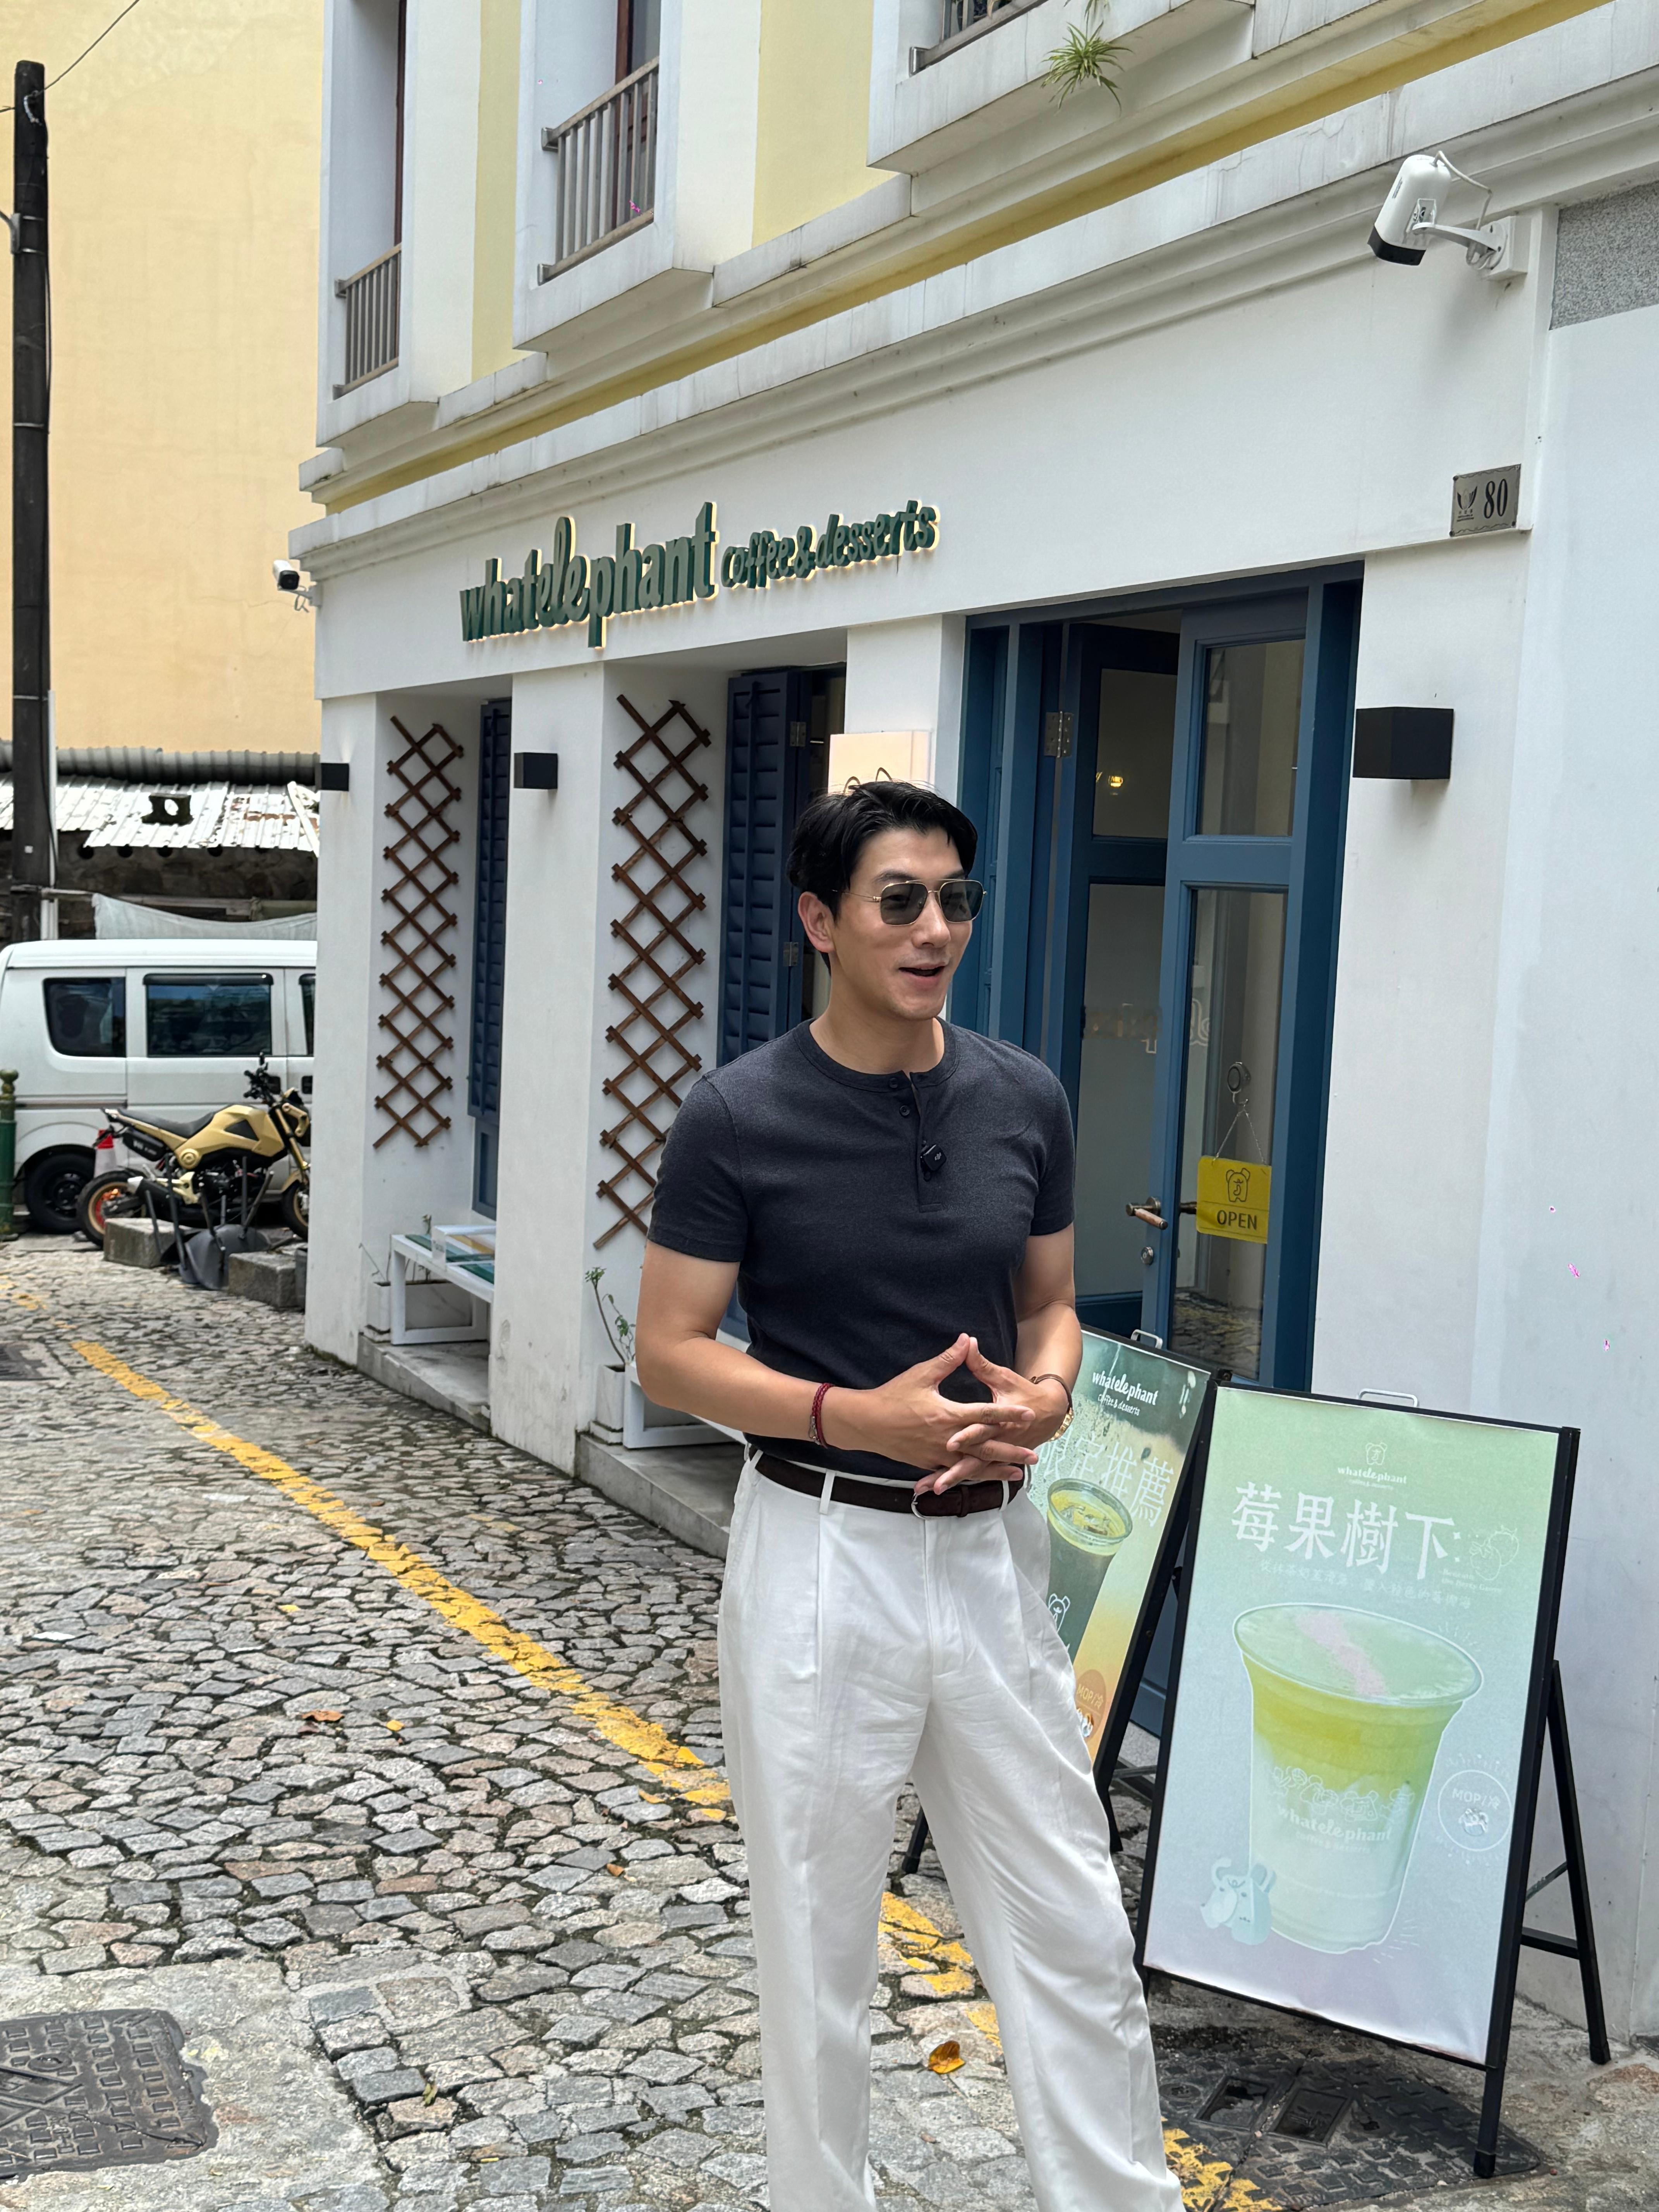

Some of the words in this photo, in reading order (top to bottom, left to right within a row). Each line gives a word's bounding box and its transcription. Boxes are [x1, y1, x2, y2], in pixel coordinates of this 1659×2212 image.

[1484, 479, 1508, 519] 80
[460, 501, 716, 648] whatelephant
[1217, 1210, 1257, 1230] OPEN
[1092, 1370, 1159, 1405] whatelephant
[1338, 1466, 1407, 1484] whatelephant
[1231, 1481, 1455, 1580] 莓果樹下
[1278, 1804, 1392, 1844] whatelephant
